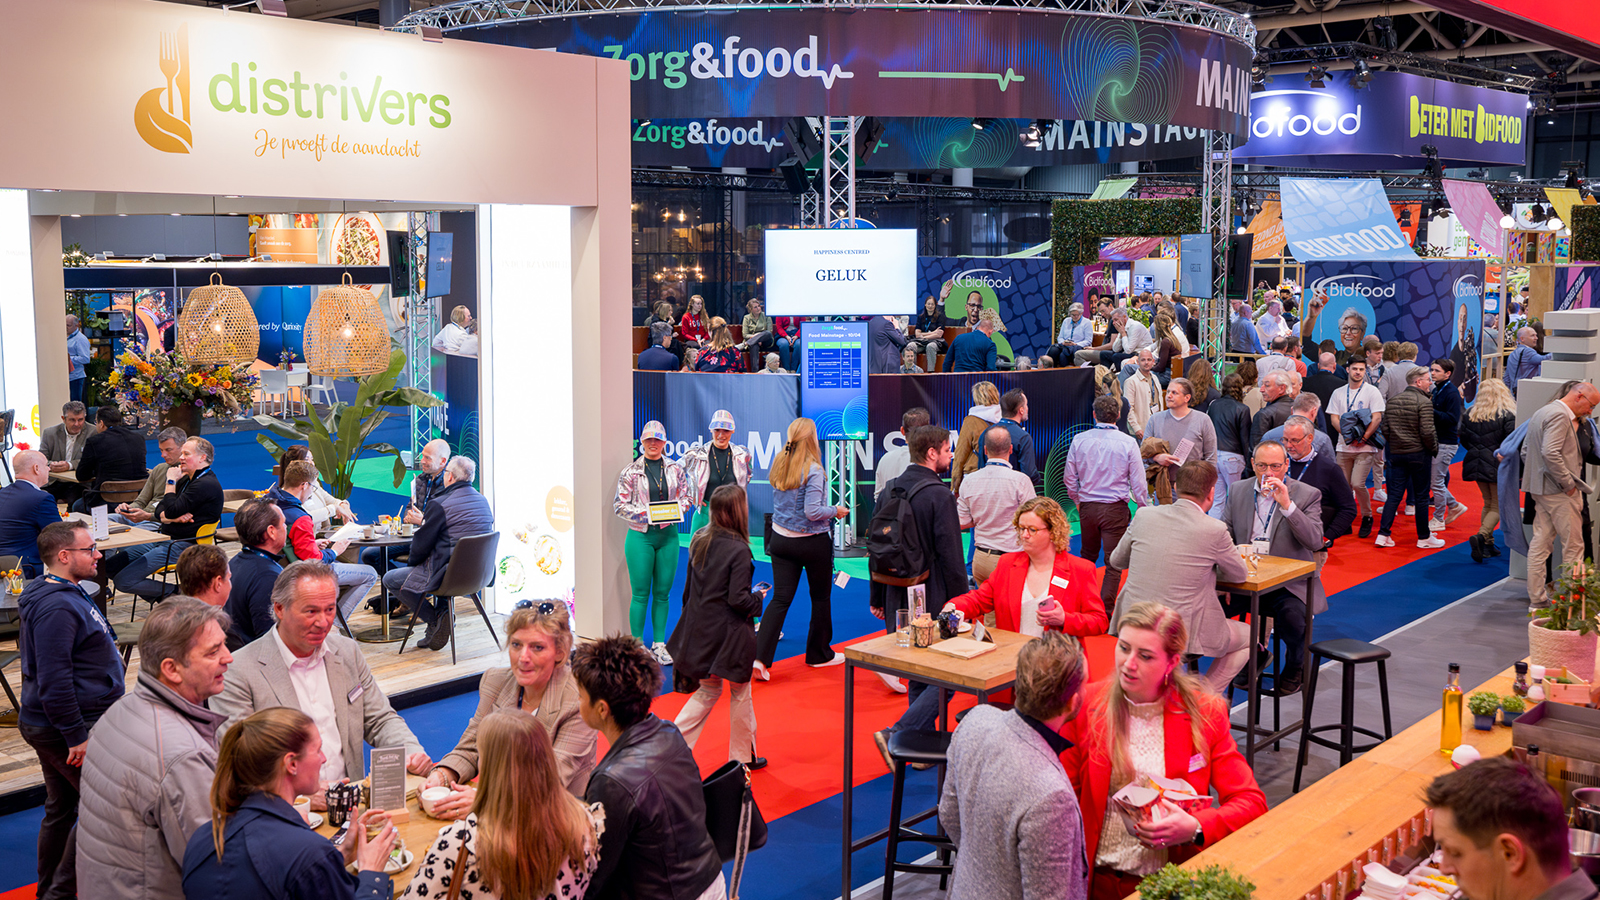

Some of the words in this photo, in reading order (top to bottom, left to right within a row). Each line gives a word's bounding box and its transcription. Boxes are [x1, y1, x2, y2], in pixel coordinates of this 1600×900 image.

[208, 61, 452, 129] distrivers
[1451, 109, 1475, 139] MET
[254, 128, 278, 157] Je
[281, 133, 328, 162] proeft
[331, 134, 350, 154] de
[352, 137, 421, 158] aandacht
[1291, 224, 1405, 258] BIDFOOD
[815, 269, 867, 282] GELUK
[965, 275, 1012, 288] Bidfood
[1089, 276, 1113, 287] Bidfood
[1330, 282, 1396, 298] Bidfood
[1460, 282, 1483, 297] Bidfood
[271, 322, 281, 332] by
